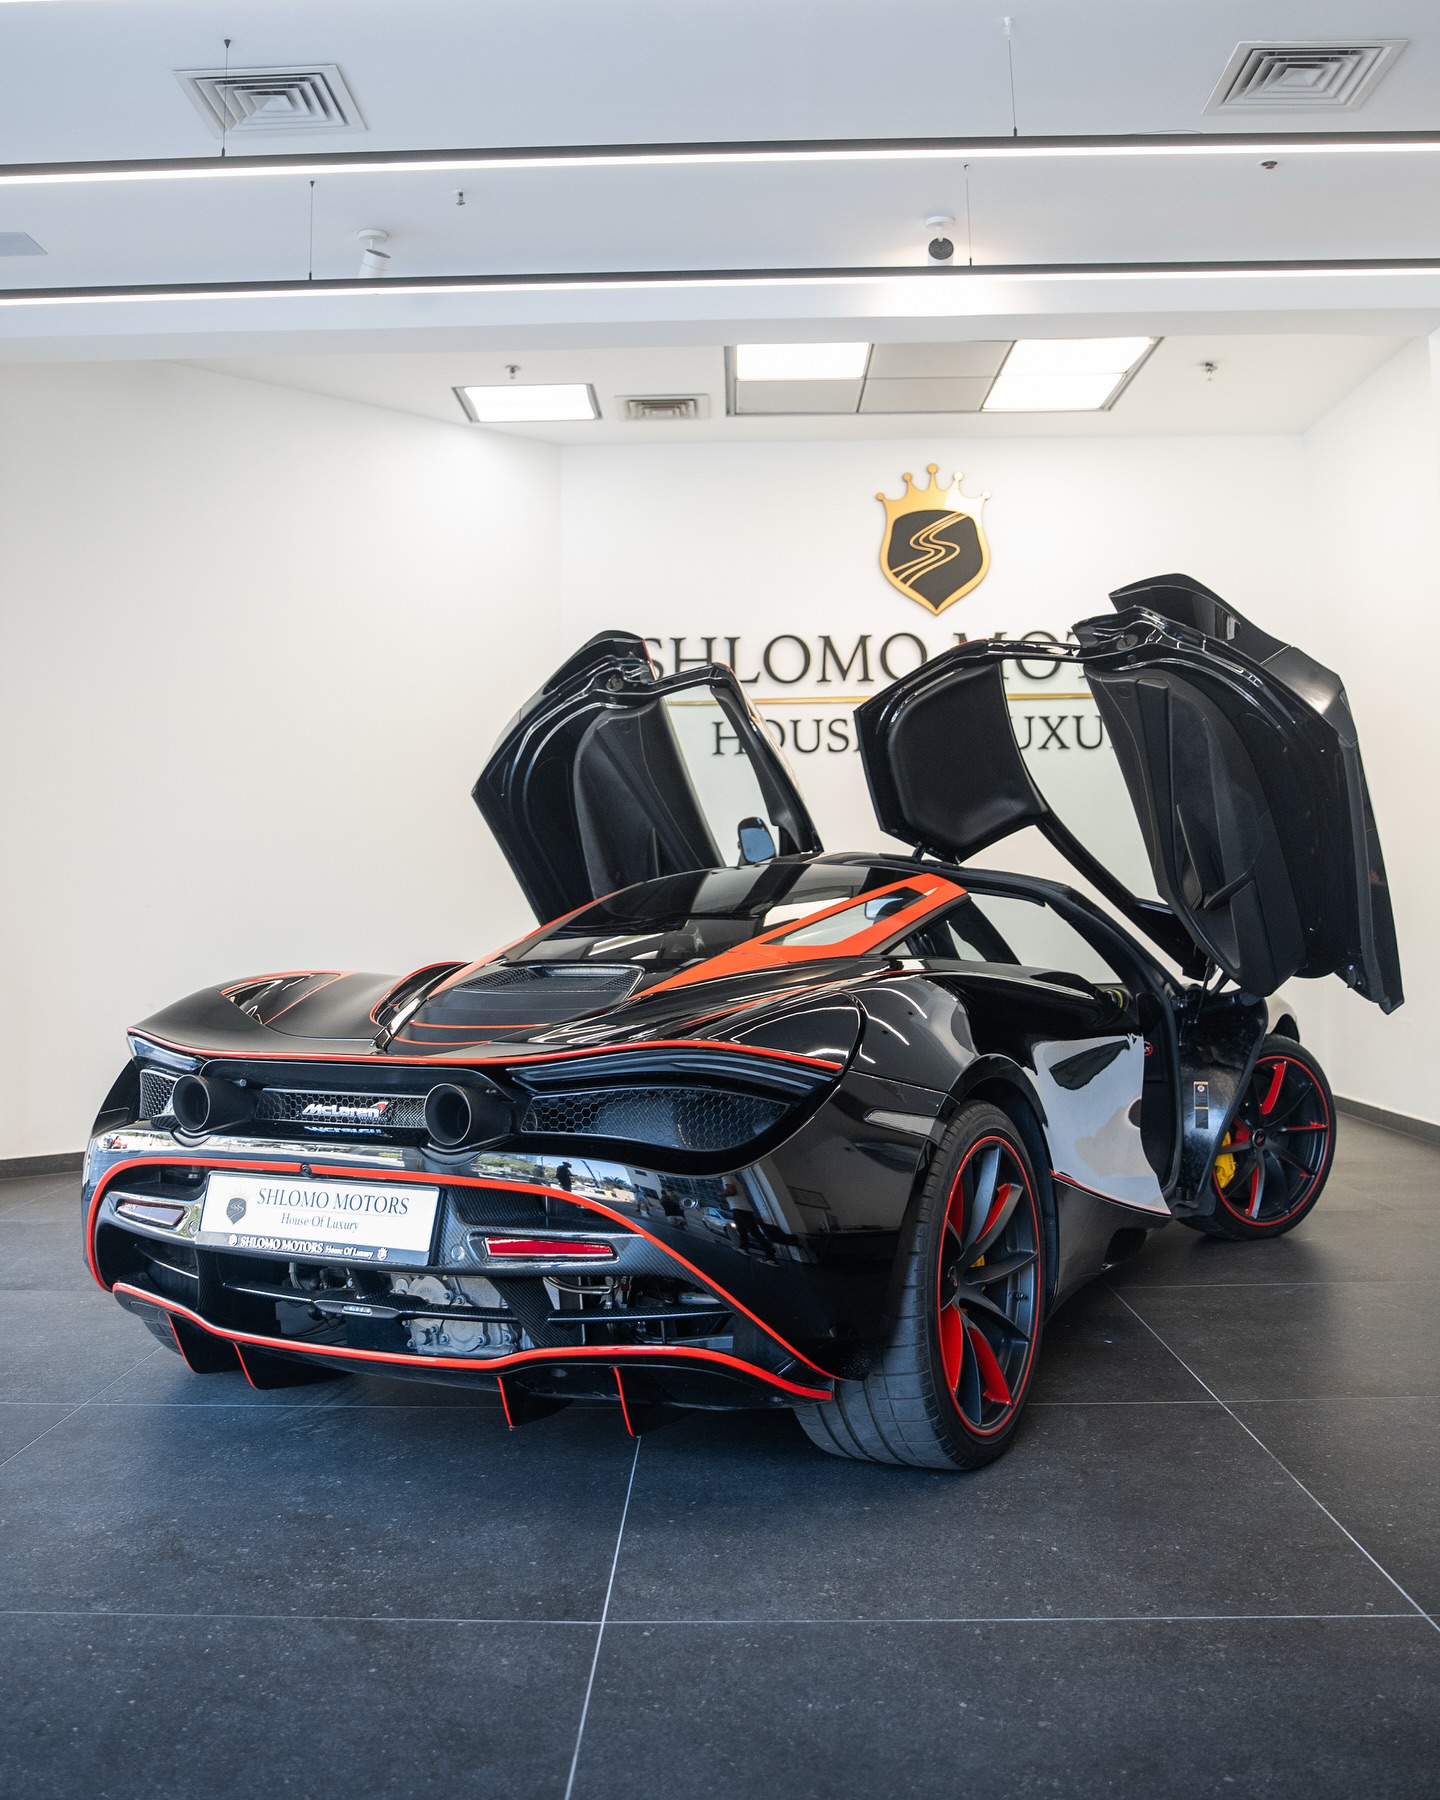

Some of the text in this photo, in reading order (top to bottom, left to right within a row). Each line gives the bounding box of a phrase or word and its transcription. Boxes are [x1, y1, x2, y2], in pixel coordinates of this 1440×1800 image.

[643, 632, 928, 684] SHLOMO
[302, 1103, 380, 1117] McLaren
[257, 1188, 409, 1215] SHLOMO MOTORS
[281, 1213, 359, 1233] House Of Luxury
[240, 1236, 282, 1250] SHLOMO
[282, 1240, 324, 1254] MOTORS
